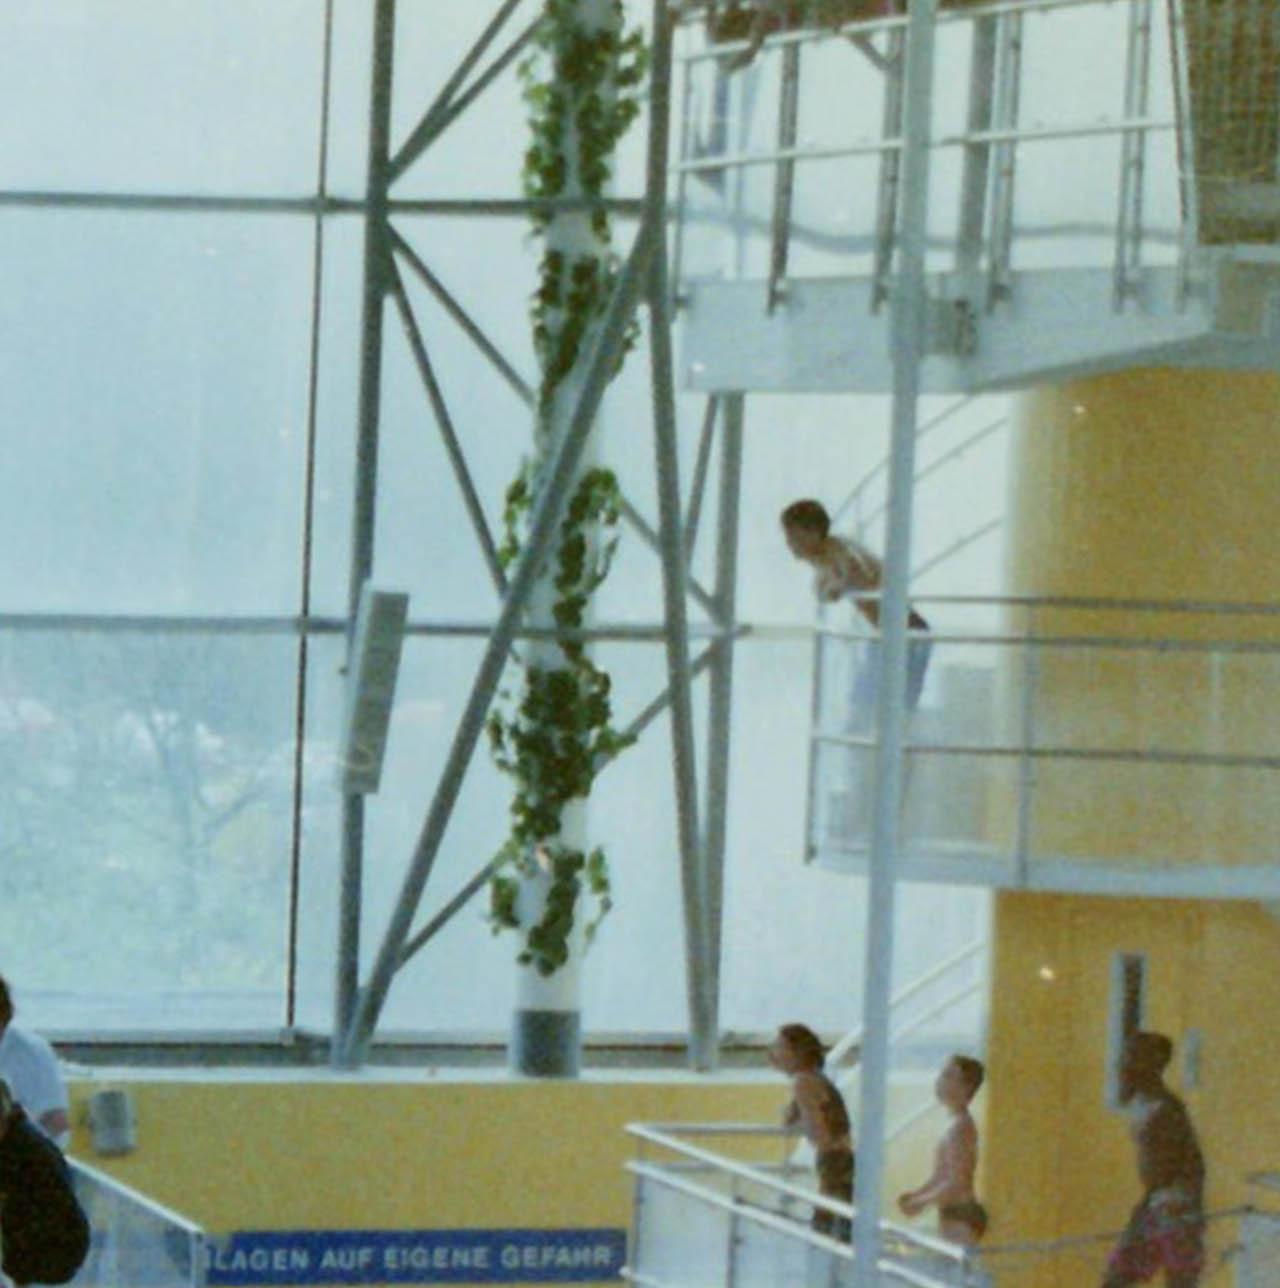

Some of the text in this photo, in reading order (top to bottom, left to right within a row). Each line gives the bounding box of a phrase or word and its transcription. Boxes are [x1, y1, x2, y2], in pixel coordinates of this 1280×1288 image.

[320, 1246, 374, 1270] AUF
[383, 1245, 490, 1269] EIGENE
[500, 1244, 612, 1268] GEFAHR
